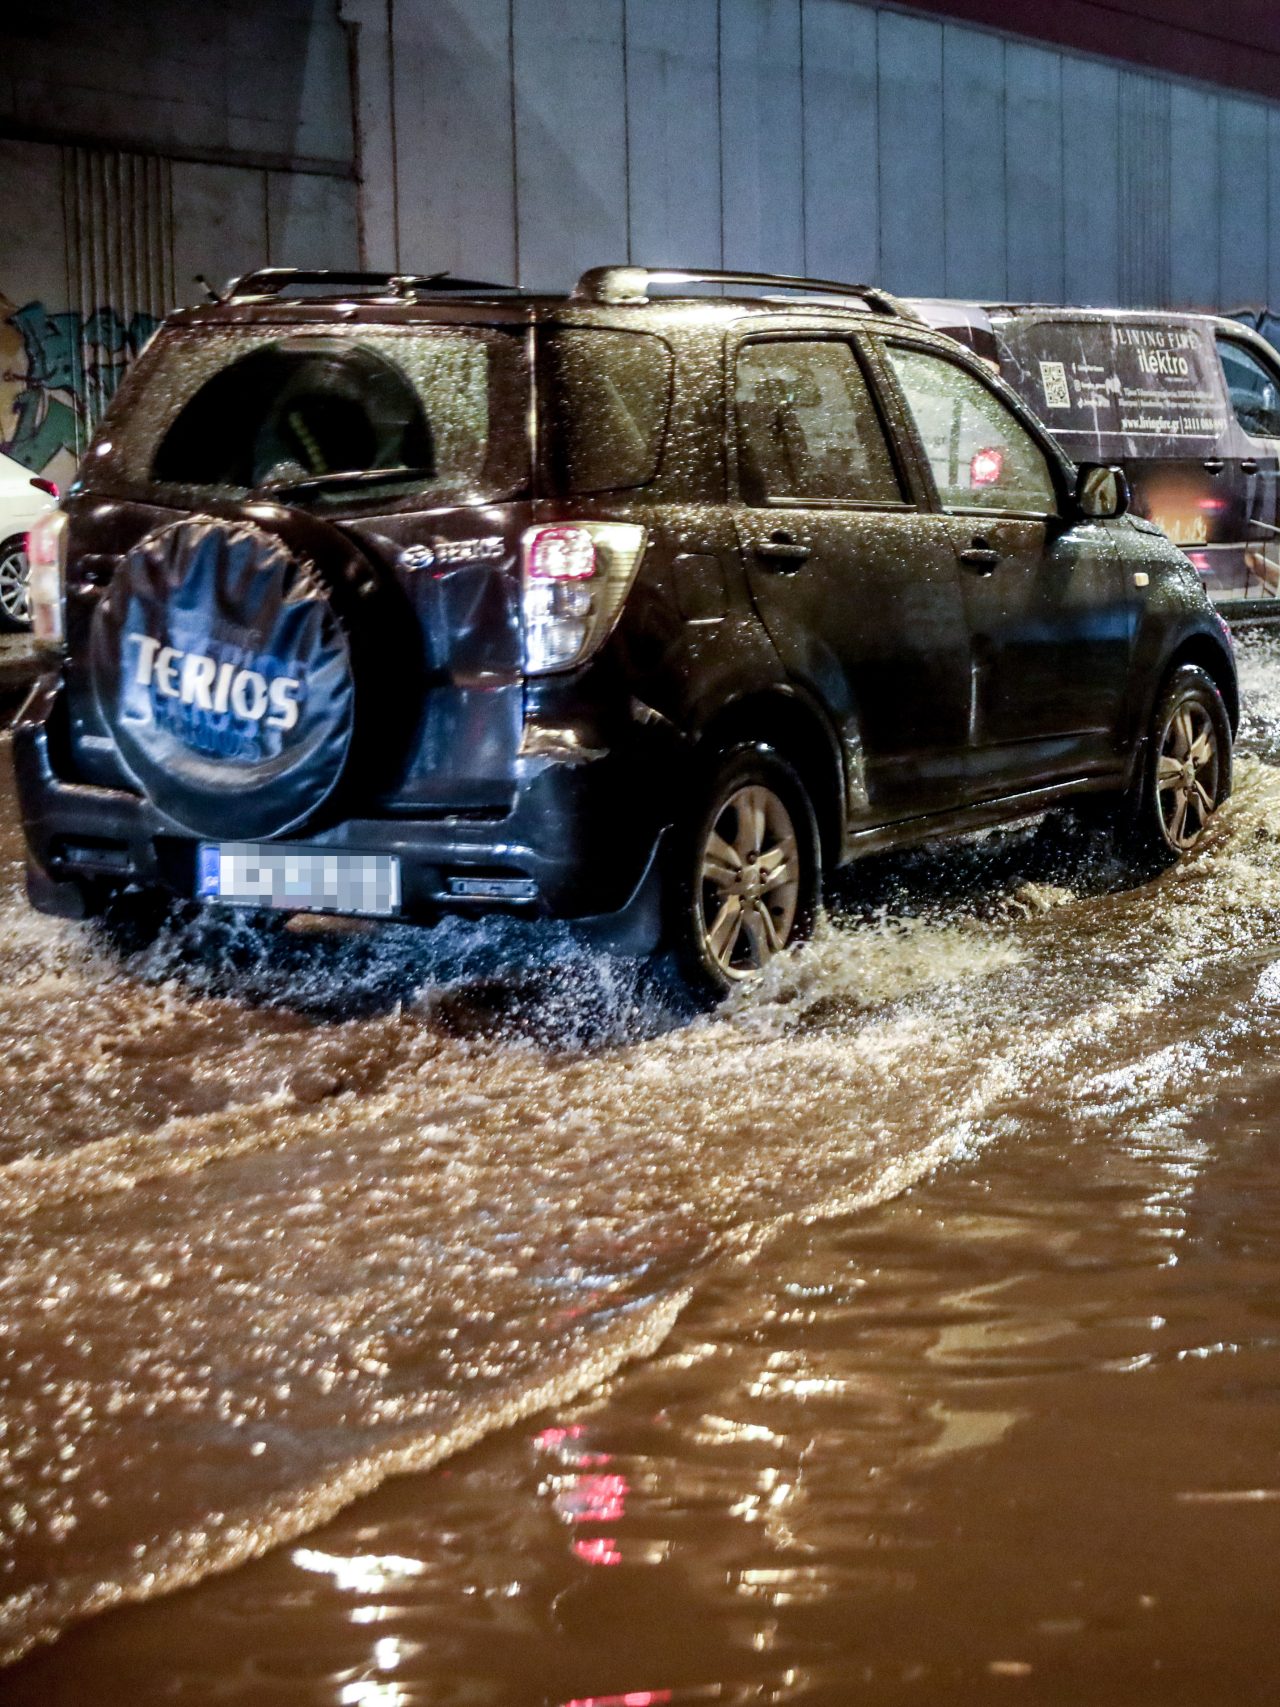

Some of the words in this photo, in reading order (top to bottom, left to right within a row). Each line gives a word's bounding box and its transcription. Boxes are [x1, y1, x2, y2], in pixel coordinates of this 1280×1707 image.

[1117, 328, 1165, 347] LIVING
[1167, 332, 1198, 350] FIRE
[128, 632, 299, 730] TERIOS
